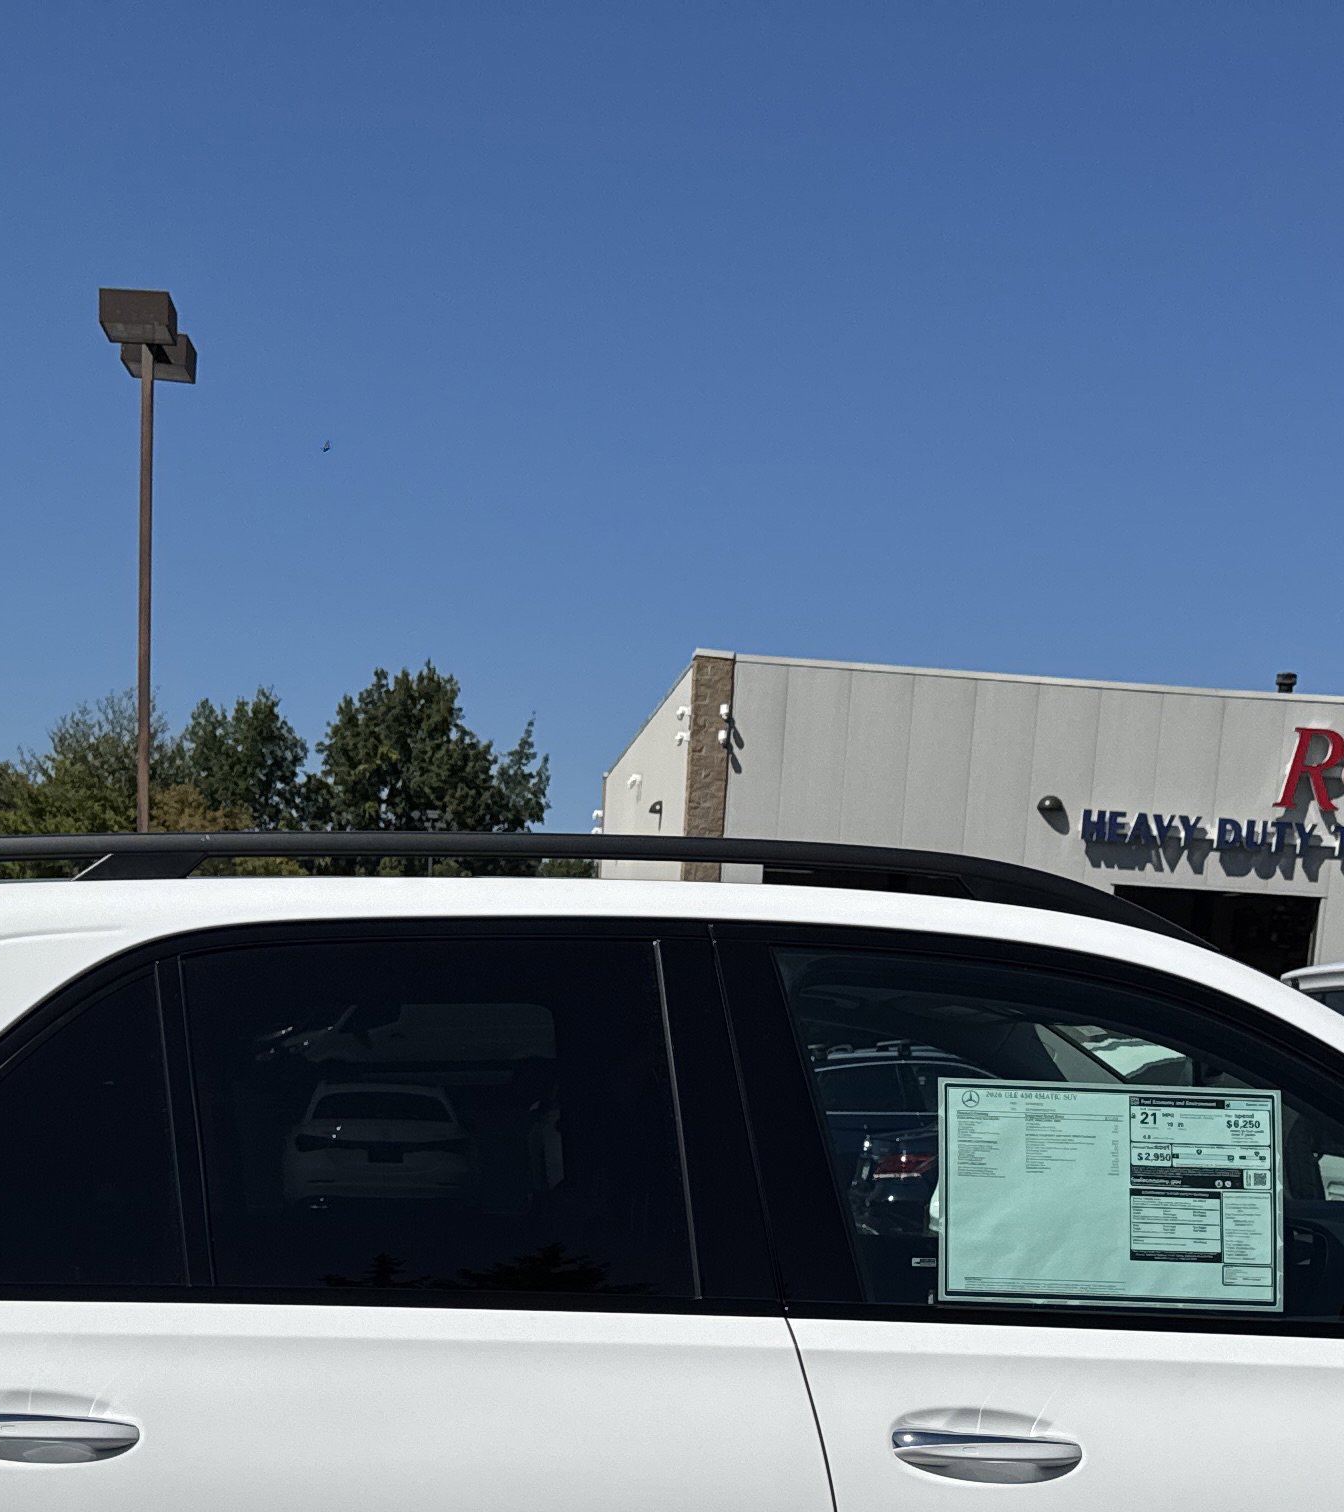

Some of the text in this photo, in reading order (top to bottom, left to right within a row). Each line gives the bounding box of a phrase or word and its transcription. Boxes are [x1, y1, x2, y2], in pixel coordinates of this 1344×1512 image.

[1080, 808, 1203, 848] HEAVY
[1215, 818, 1318, 857] DUTY
[1140, 1111, 1157, 1125] 21
[1137, 1152, 1171, 1162] $2,950
